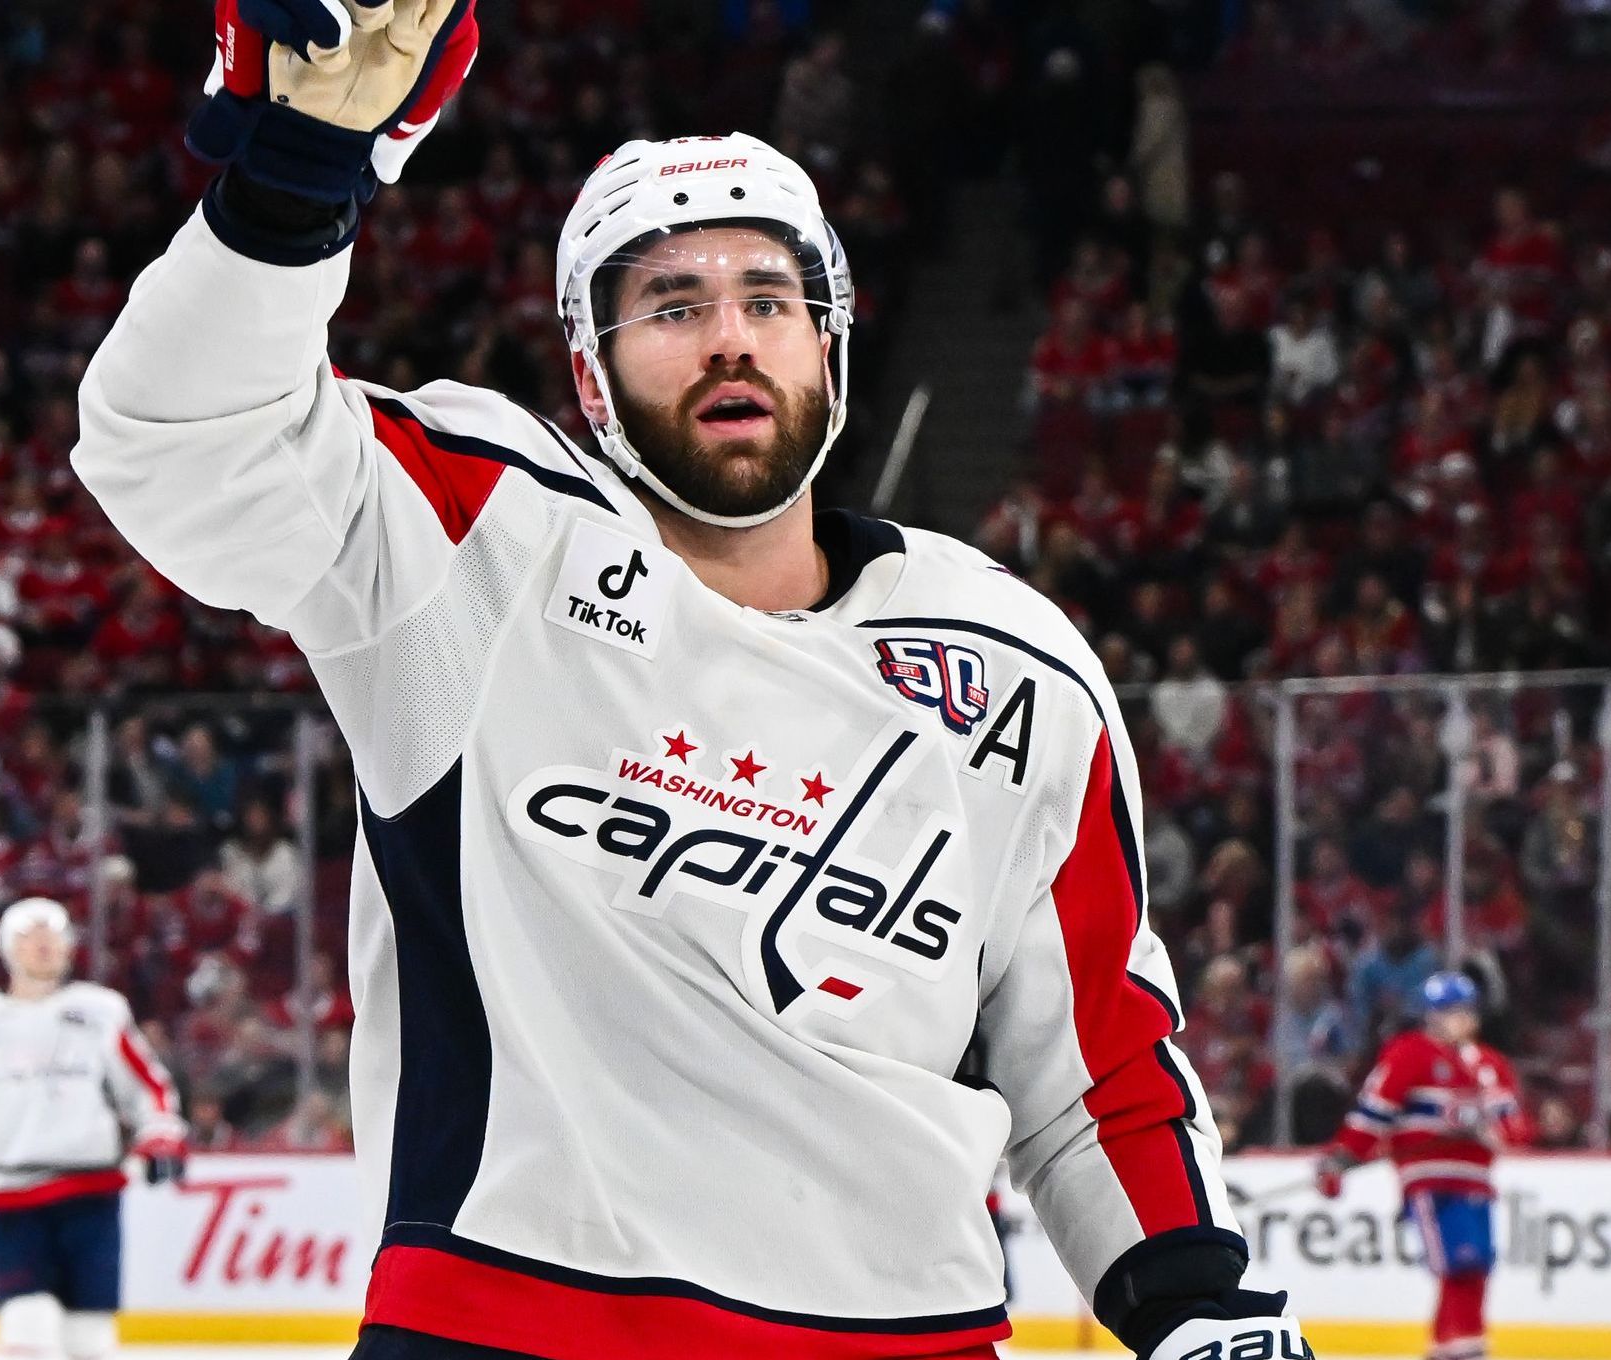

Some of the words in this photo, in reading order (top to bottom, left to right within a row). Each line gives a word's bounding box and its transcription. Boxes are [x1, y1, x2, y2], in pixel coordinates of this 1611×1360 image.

[568, 595, 647, 644] TikTok
[881, 638, 986, 721] 50
[896, 665, 916, 676] EST
[968, 676, 1036, 786] A
[618, 758, 821, 836] WASHINGTON
[179, 1174, 349, 1286] Tim
[1227, 1180, 1422, 1265] reat
